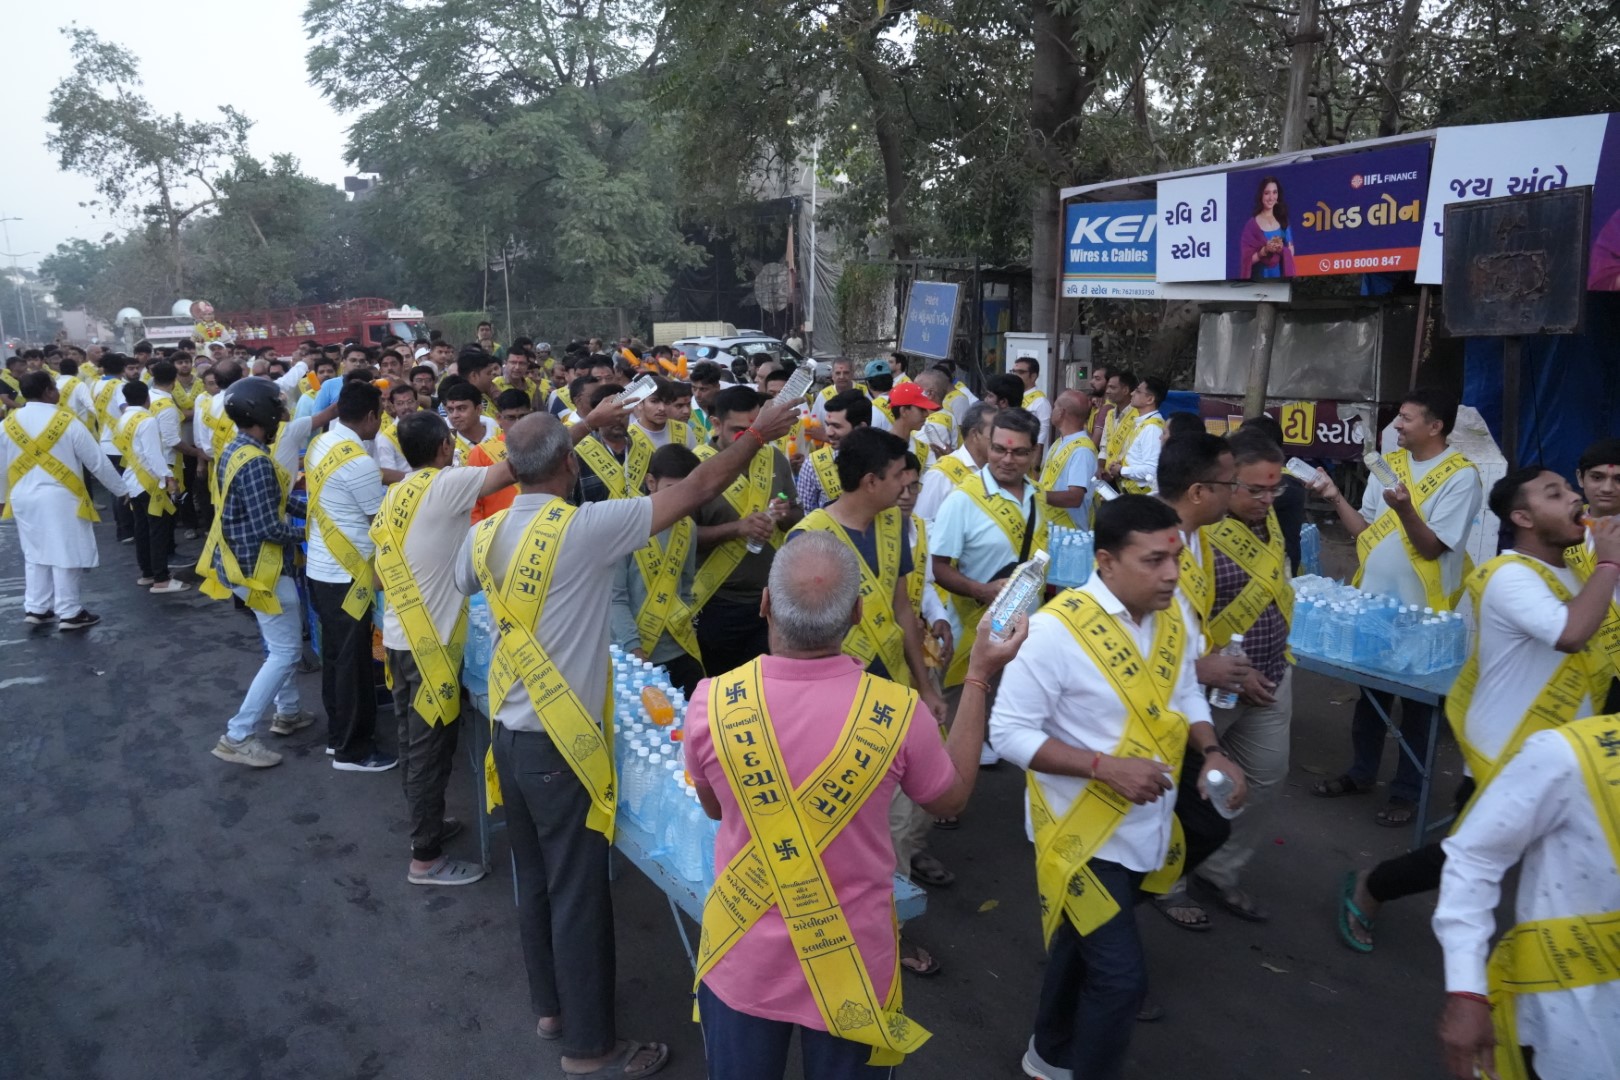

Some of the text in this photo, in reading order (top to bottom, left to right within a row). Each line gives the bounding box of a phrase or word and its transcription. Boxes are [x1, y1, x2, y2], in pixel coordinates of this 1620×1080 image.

[1364, 171, 1418, 186] IIFL FINANCE
[1450, 178, 1493, 198] જય
[1165, 198, 1217, 226] રવિ ટી
[1302, 193, 1420, 231] ગોલ્ડ લોન
[1070, 248, 1148, 263] Wires & Cables
[1171, 236, 1210, 260] સ્ટોલ
[1333, 256, 1401, 269] 810 8000 847
[1067, 284, 1078, 295] રવિ
[1284, 408, 1308, 441] ટી
[733, 730, 782, 808] પદયાત્રા
[808, 748, 873, 820] પદયાત્રા
[792, 913, 840, 933] કારેલીબાગ
[801, 934, 849, 955] કલાલીધામ
